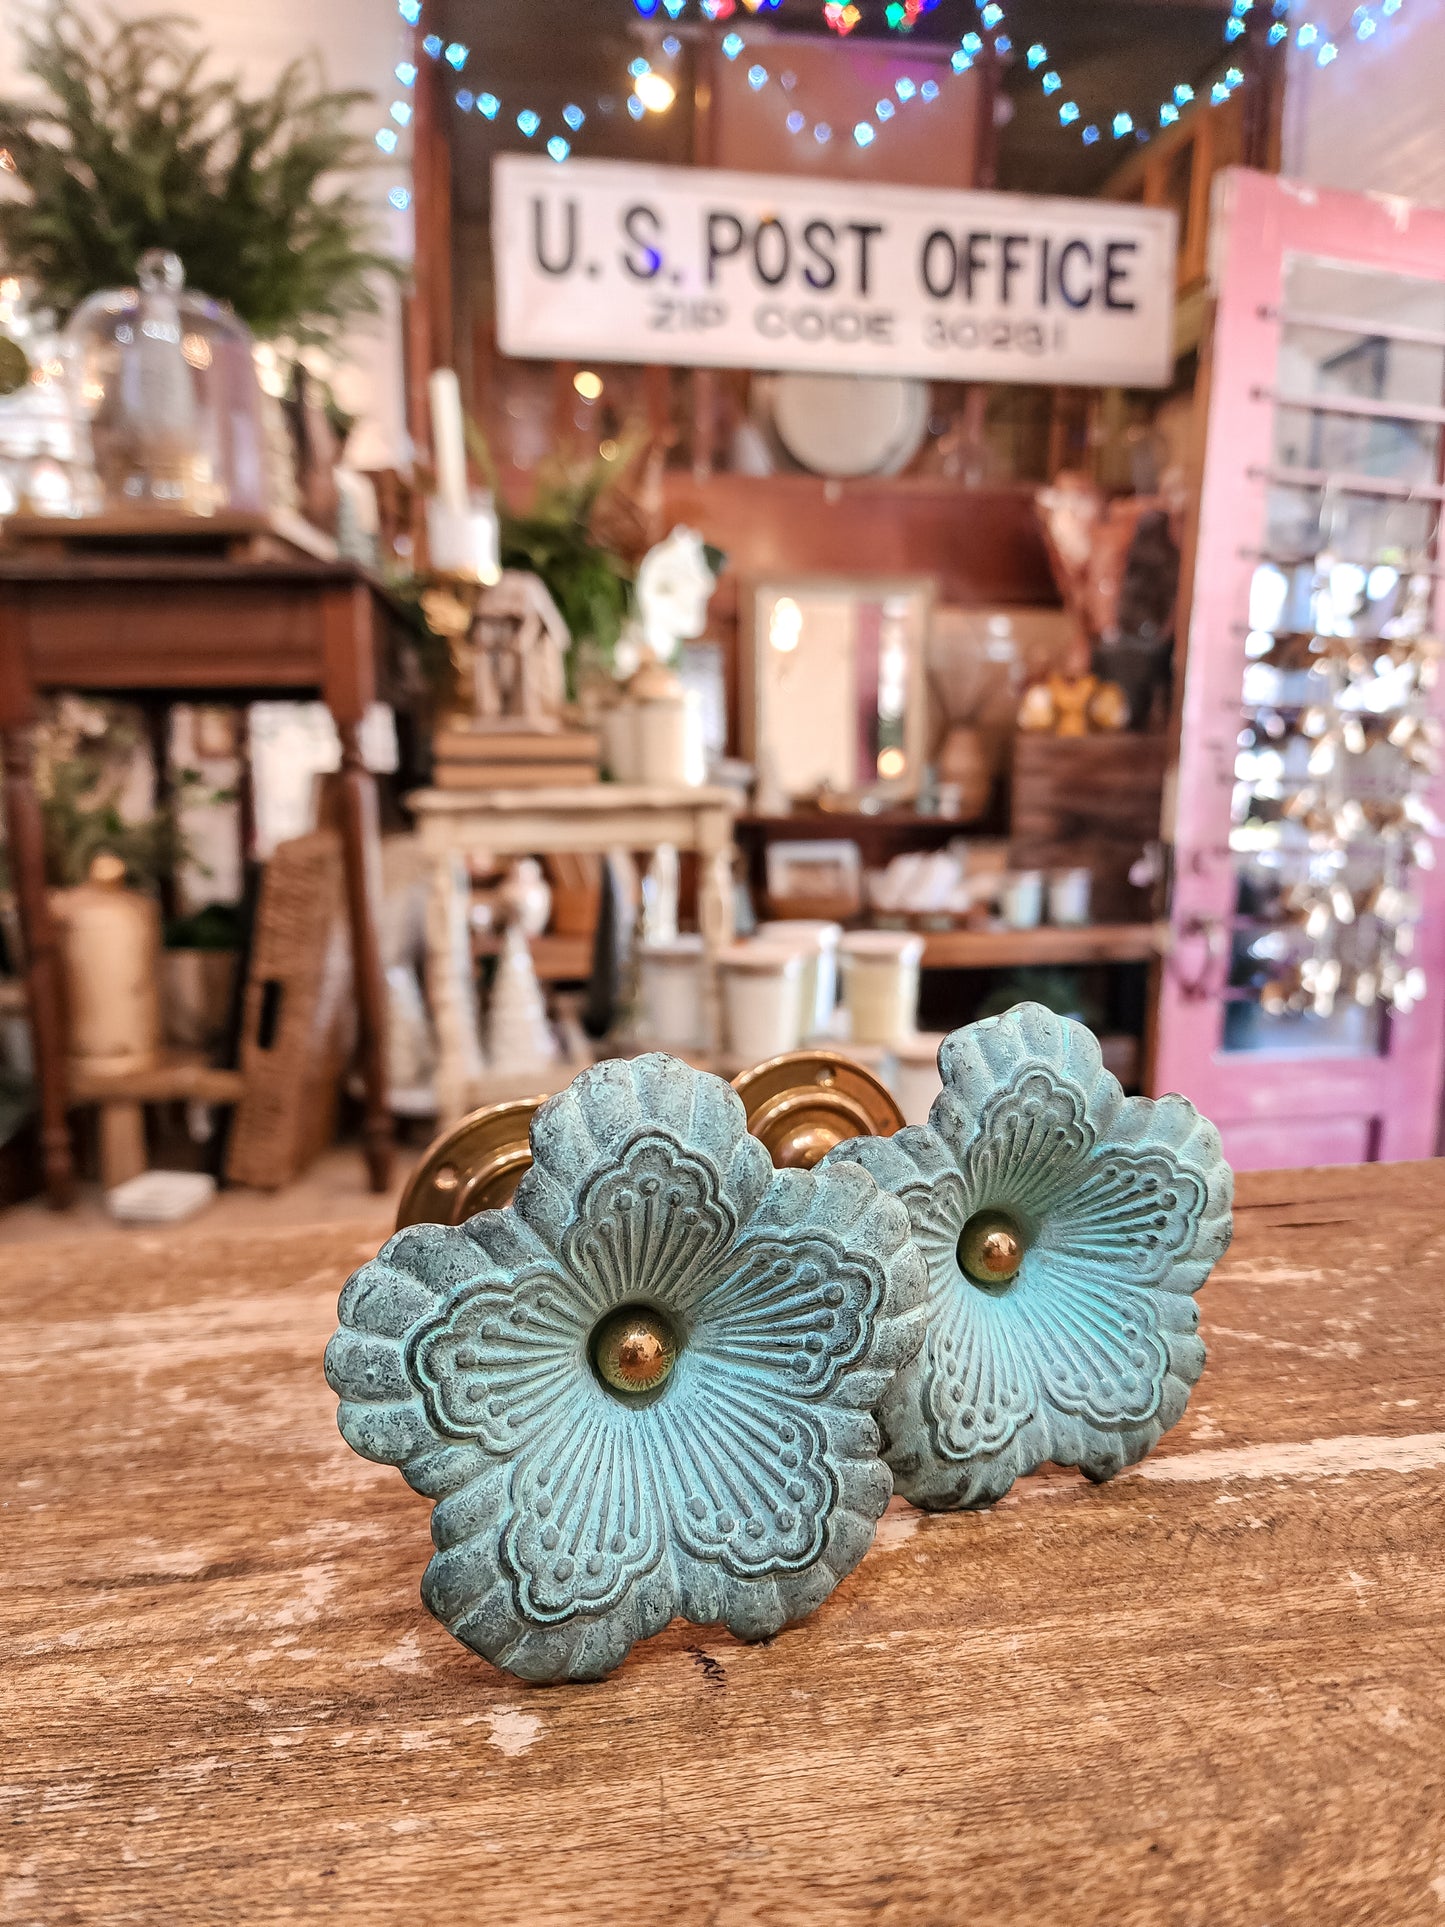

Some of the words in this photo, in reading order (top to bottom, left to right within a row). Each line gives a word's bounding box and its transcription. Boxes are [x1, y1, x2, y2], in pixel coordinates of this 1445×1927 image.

[705, 211, 883, 297] POST
[920, 229, 1138, 310] OFFICE
[648, 298, 728, 332] ZIP
[753, 302, 896, 345] CODE
